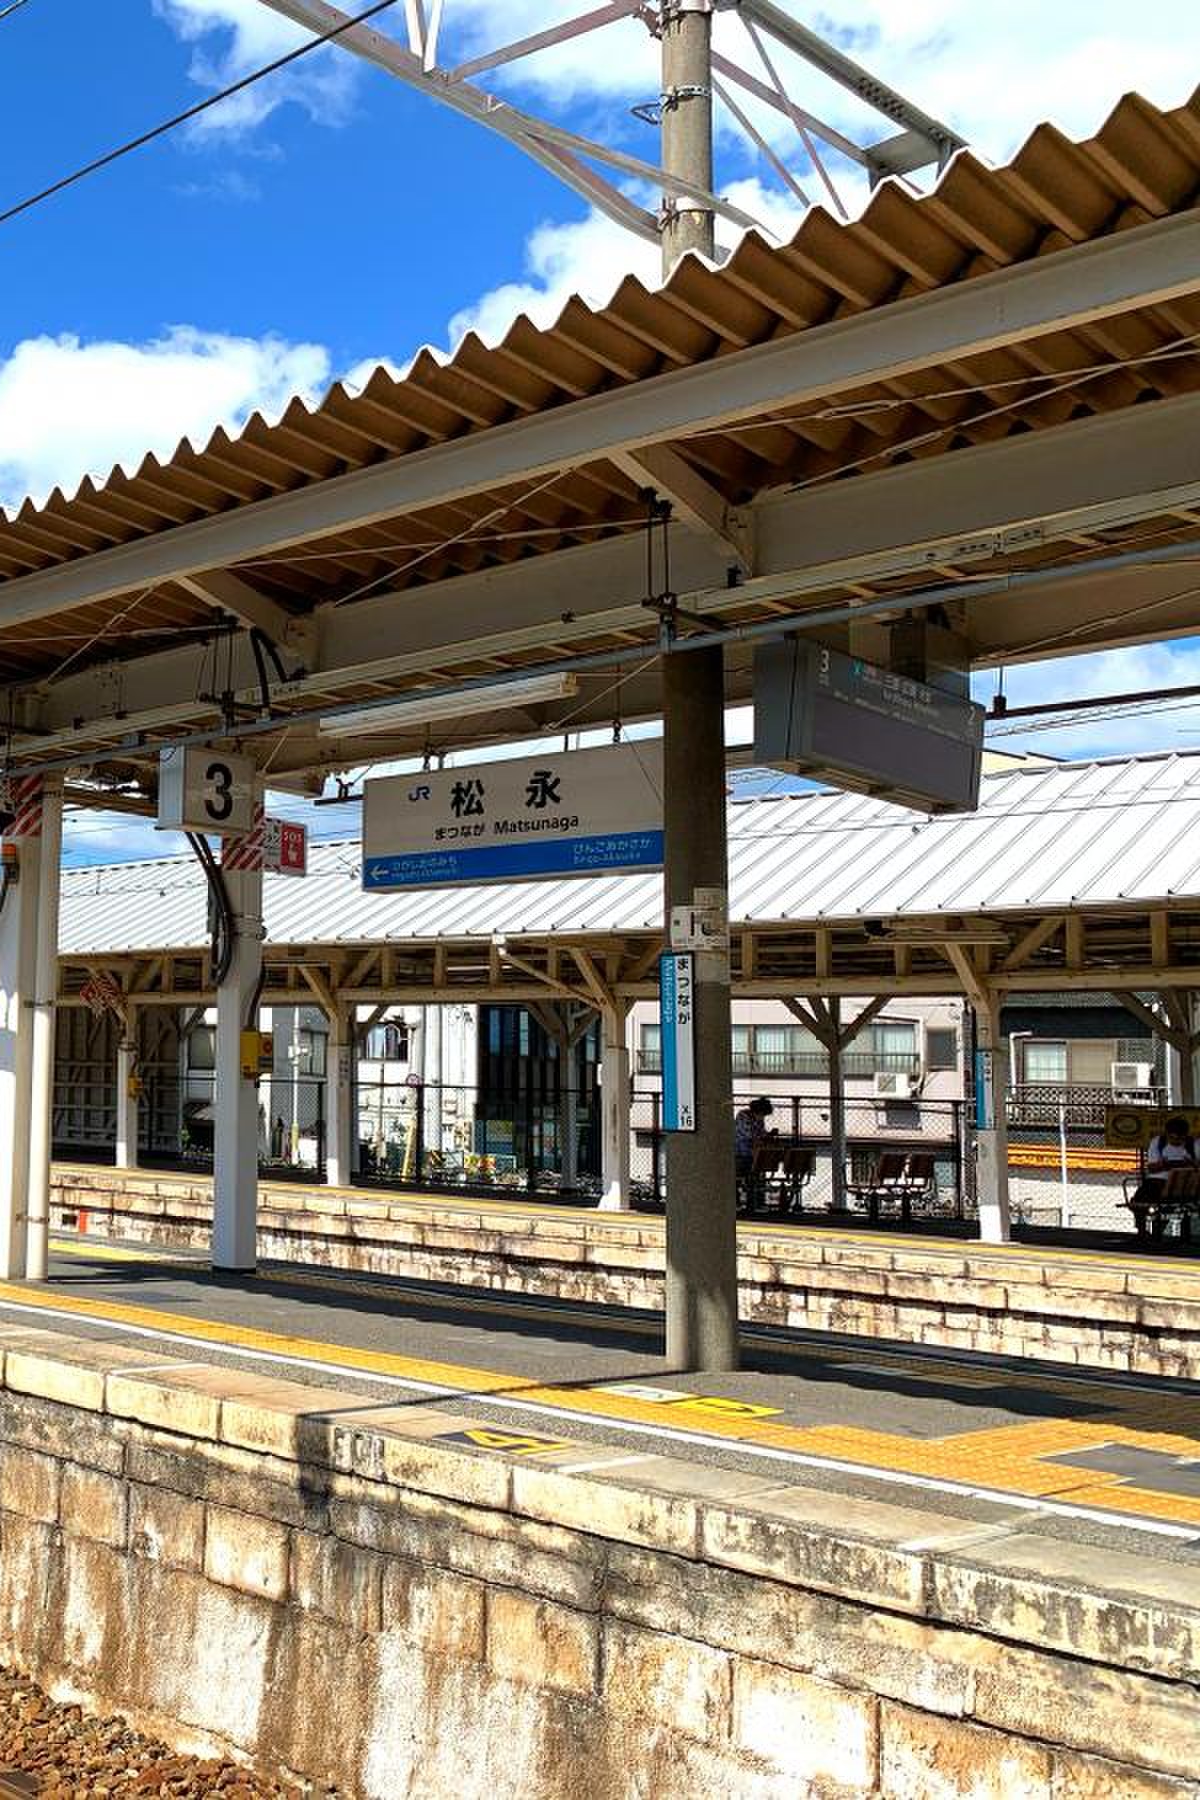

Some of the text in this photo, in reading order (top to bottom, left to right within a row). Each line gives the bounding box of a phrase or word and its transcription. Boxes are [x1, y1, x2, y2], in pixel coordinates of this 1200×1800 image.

[820, 649, 830, 673] 3
[205, 763, 233, 820] 3
[407, 785, 432, 802] JR
[450, 770, 561, 818] 松永
[433, 814, 579, 841] まつなが Matsunaga
[677, 957, 691, 1025] まつなが
